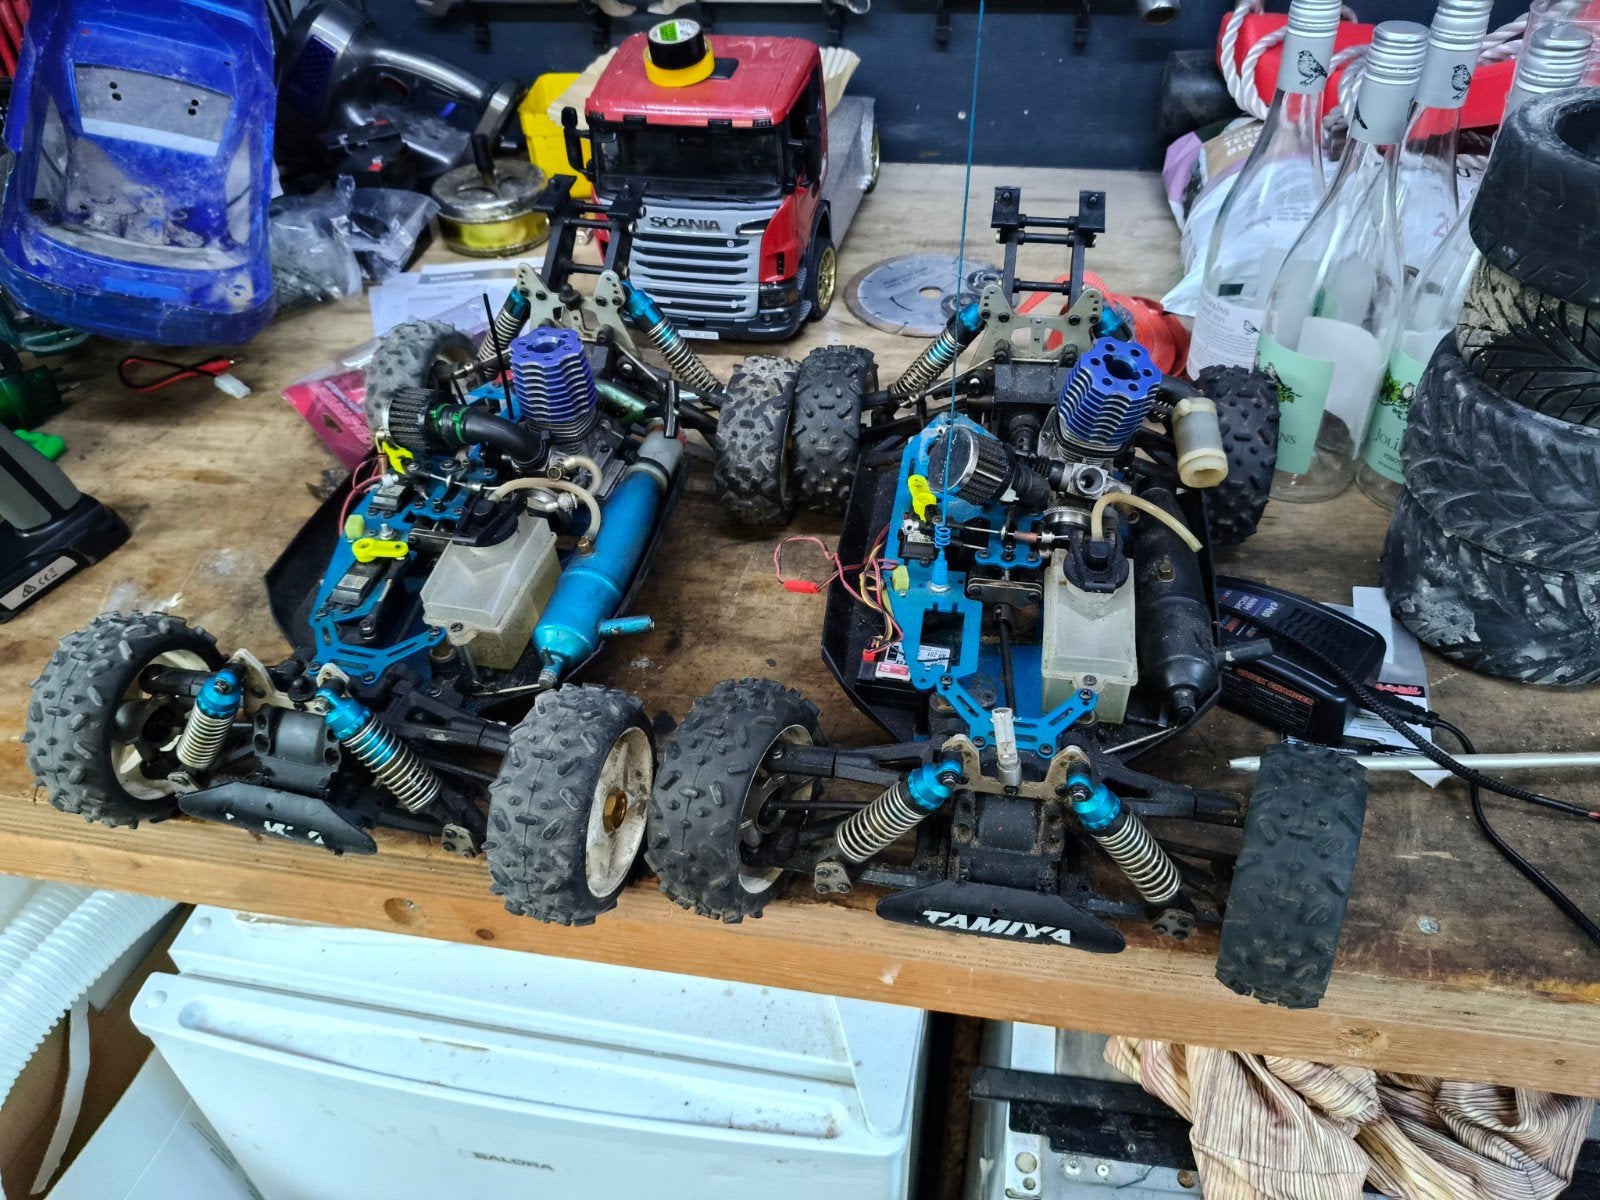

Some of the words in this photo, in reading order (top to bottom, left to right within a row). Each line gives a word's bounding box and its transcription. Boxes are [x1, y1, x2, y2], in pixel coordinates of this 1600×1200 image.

[650, 216, 721, 231] SCANIA
[1266, 681, 1315, 707] CHARGER
[922, 910, 1071, 945] TAMIYA
[473, 1151, 554, 1171] SALORA
